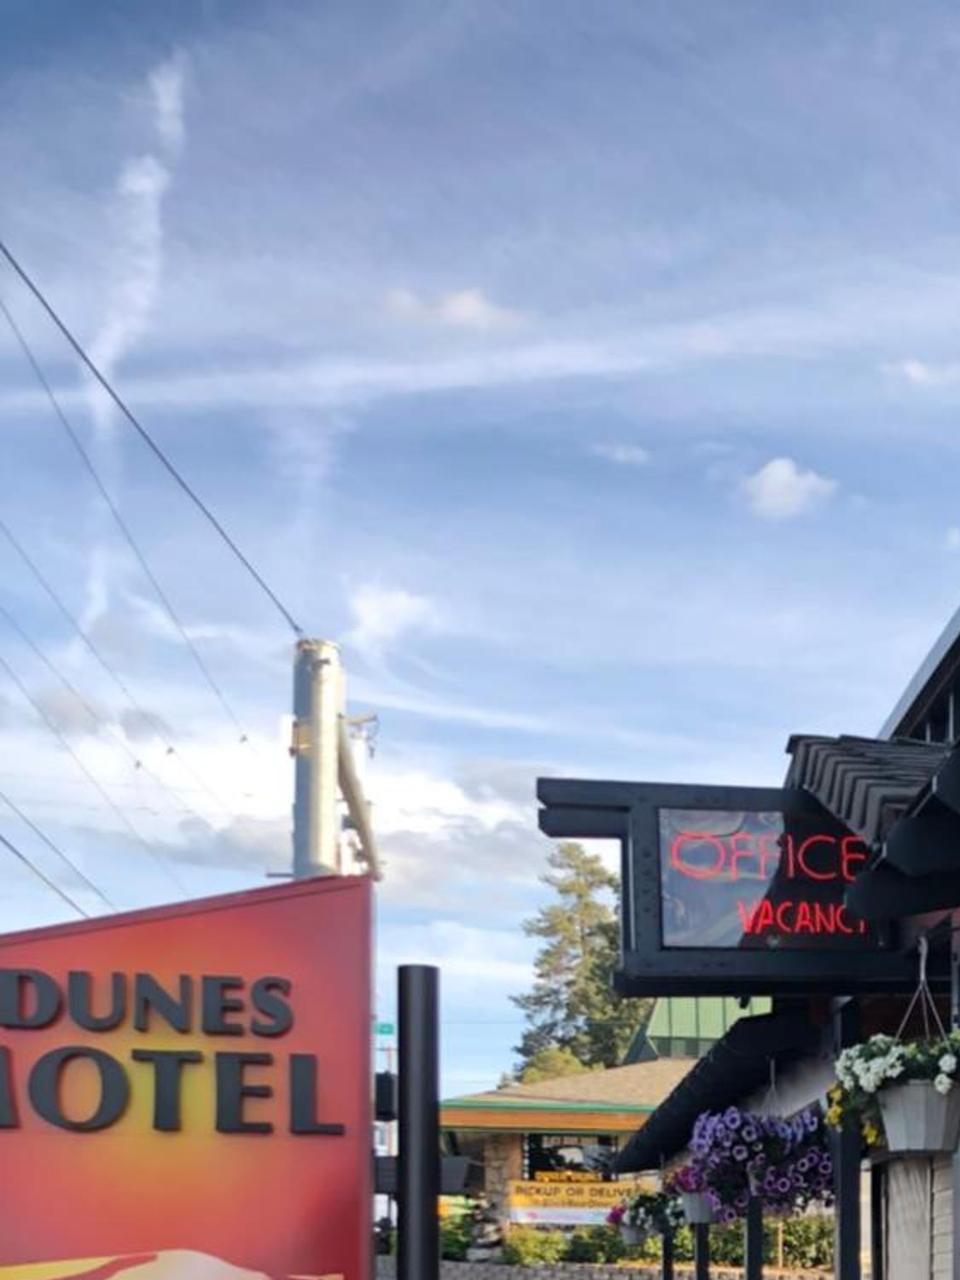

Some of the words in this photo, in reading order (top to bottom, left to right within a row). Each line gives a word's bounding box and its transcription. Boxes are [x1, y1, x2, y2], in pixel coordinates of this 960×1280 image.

[671, 832, 866, 880] OFFICE
[738, 899, 865, 934] VACANC
[0, 969, 294, 1038] DUNES
[514, 1185, 562, 1198] PICKUP
[565, 1186, 585, 1198] OR
